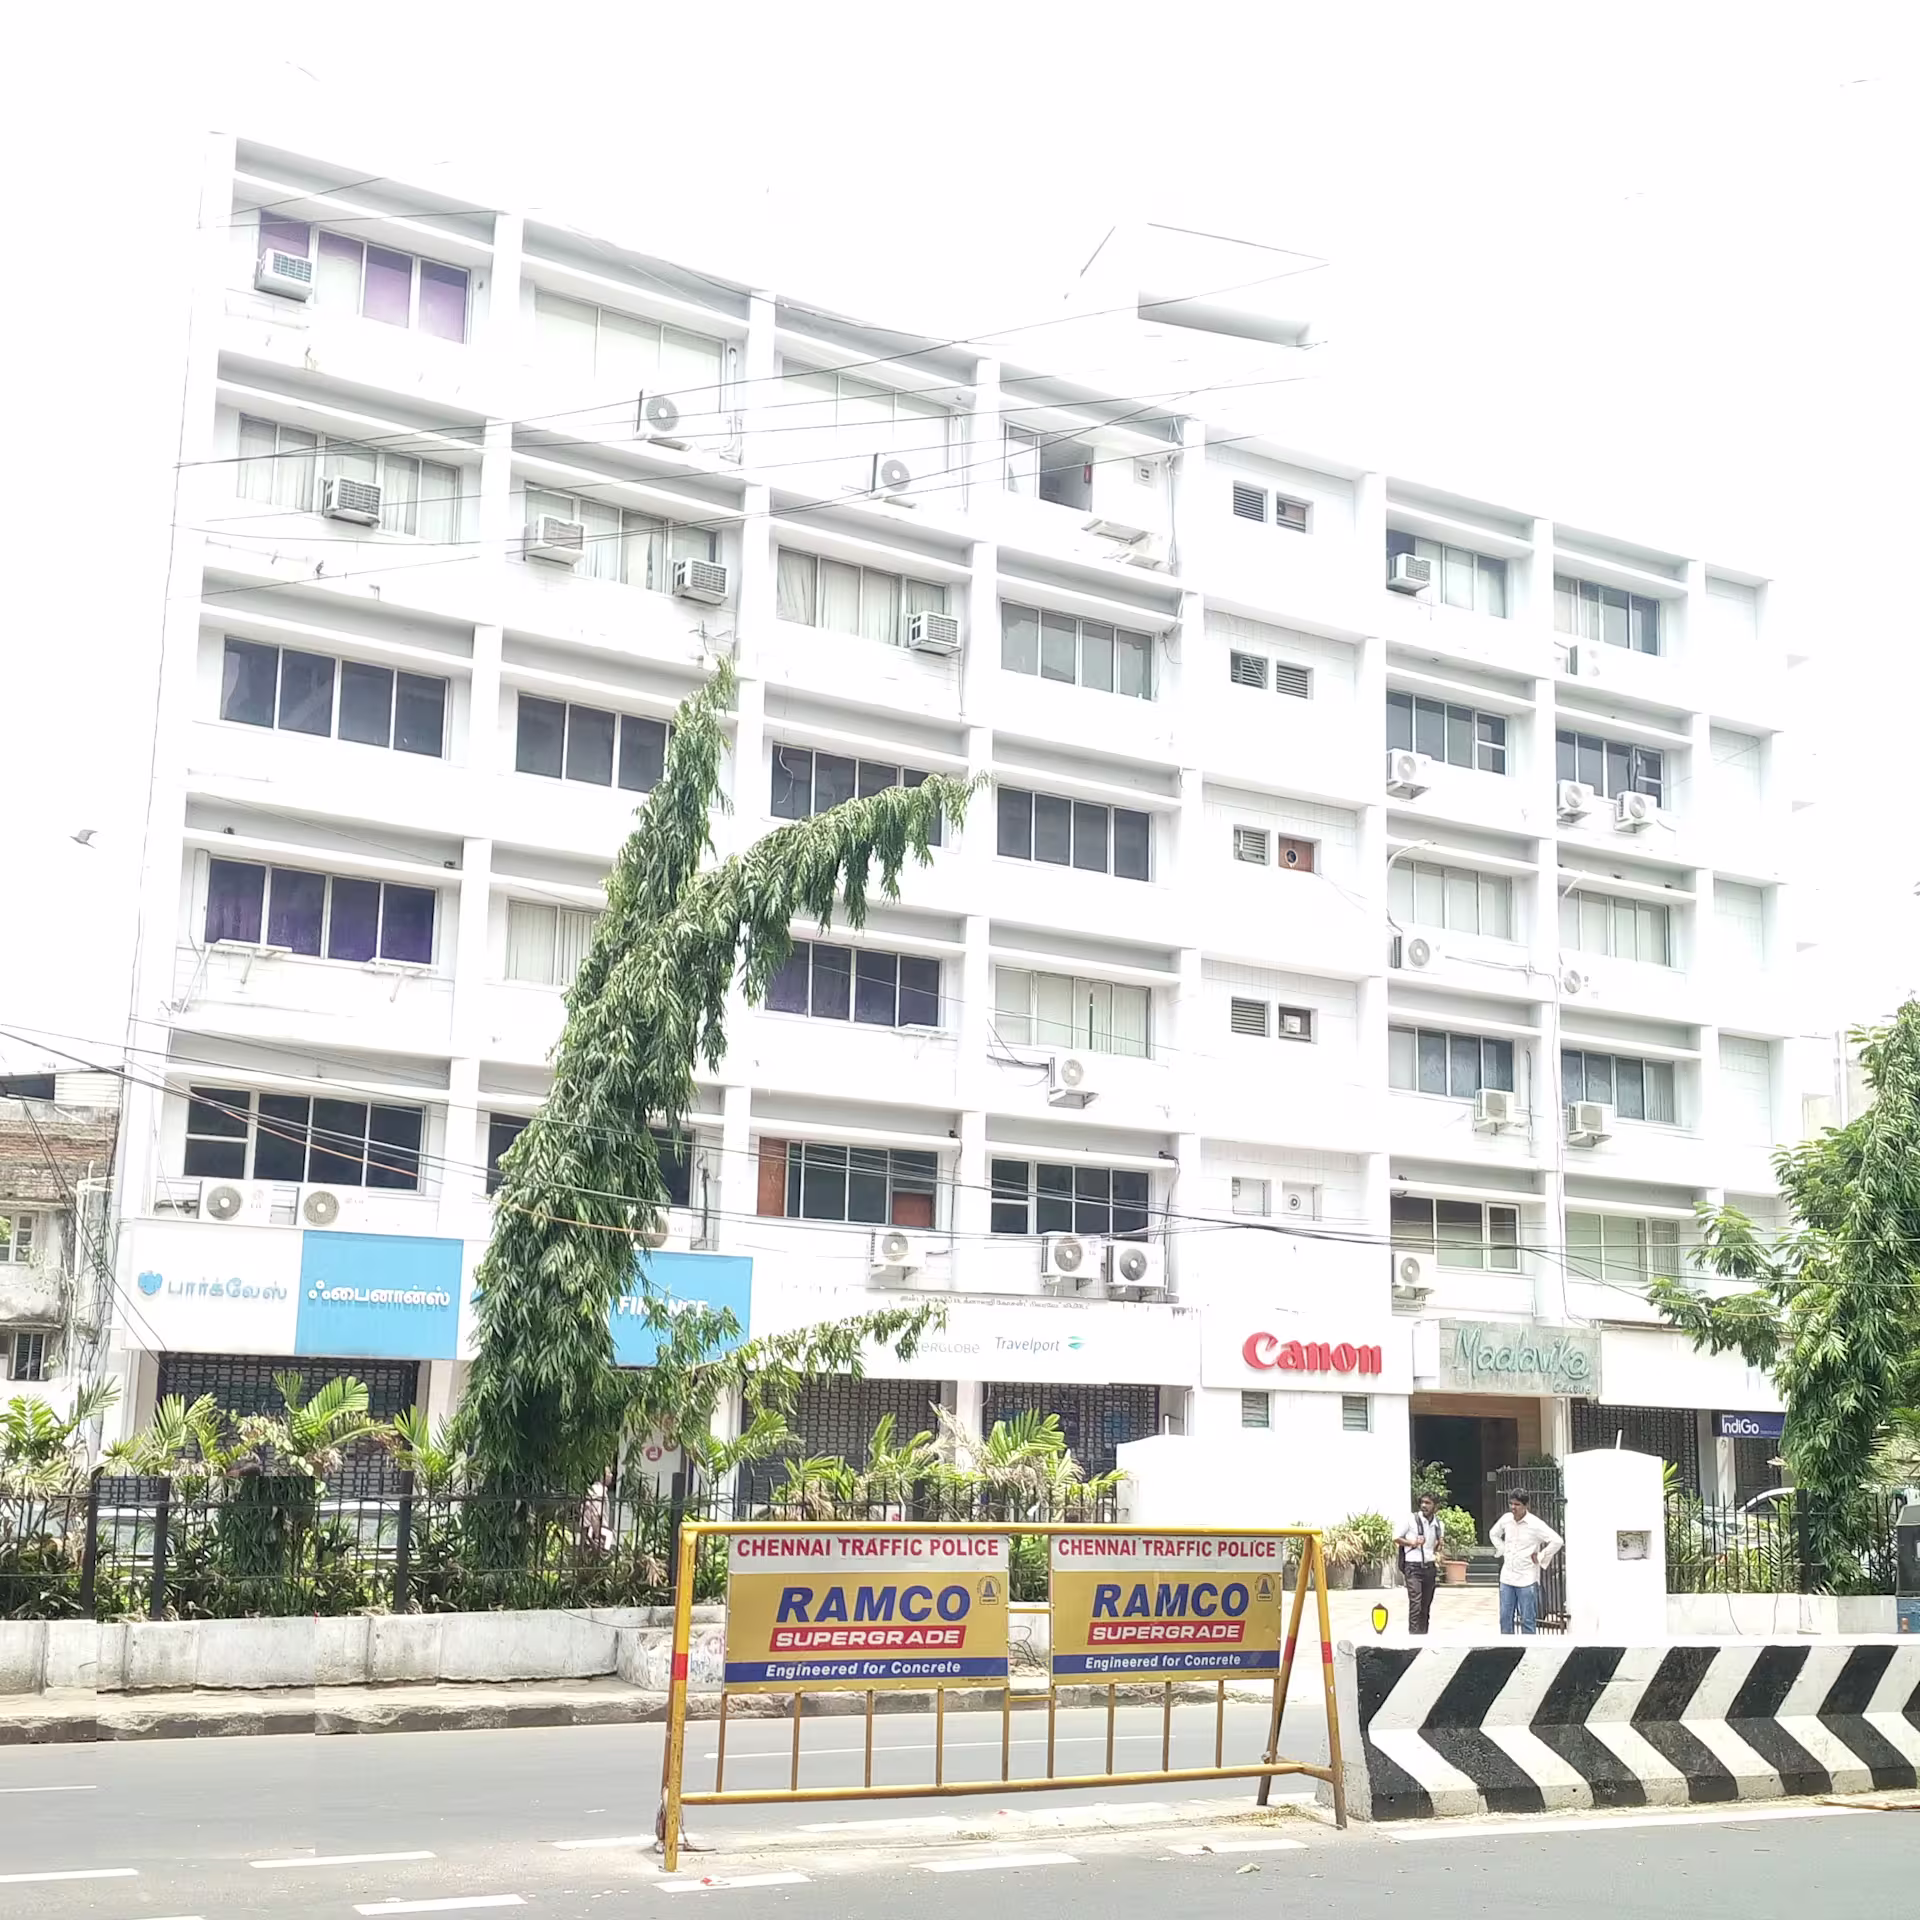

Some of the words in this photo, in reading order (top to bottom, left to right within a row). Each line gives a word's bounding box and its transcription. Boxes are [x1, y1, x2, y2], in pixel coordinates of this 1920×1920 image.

[308, 1280, 451, 1306] ஃபைனான்ஸ்
[617, 1295, 709, 1319] FINNE
[995, 1336, 1060, 1354] Travelport
[1242, 1331, 1383, 1375] Canon
[1722, 1417, 1760, 1435] IndiGo
[737, 1538, 831, 1557] CHENNAI
[838, 1538, 923, 1557] TRAFFIC
[929, 1539, 999, 1556] POLICE
[1058, 1539, 1137, 1557] CHENNAI
[1142, 1540, 1212, 1557] TRAFFIC
[1218, 1541, 1276, 1557] POLICE
[776, 1585, 971, 1623] RAMCO
[1092, 1582, 1249, 1618] RAMCO
[775, 1630, 960, 1647] SUPERGRADE
[1092, 1624, 1240, 1640] SUPERGRADE
[766, 1662, 858, 1679] Engineered
[863, 1662, 886, 1675] for
[891, 1661, 961, 1675] Concrete
[1085, 1655, 1158, 1671] Engineered
[1162, 1655, 1181, 1667] for
[1185, 1653, 1242, 1667] Concrete
